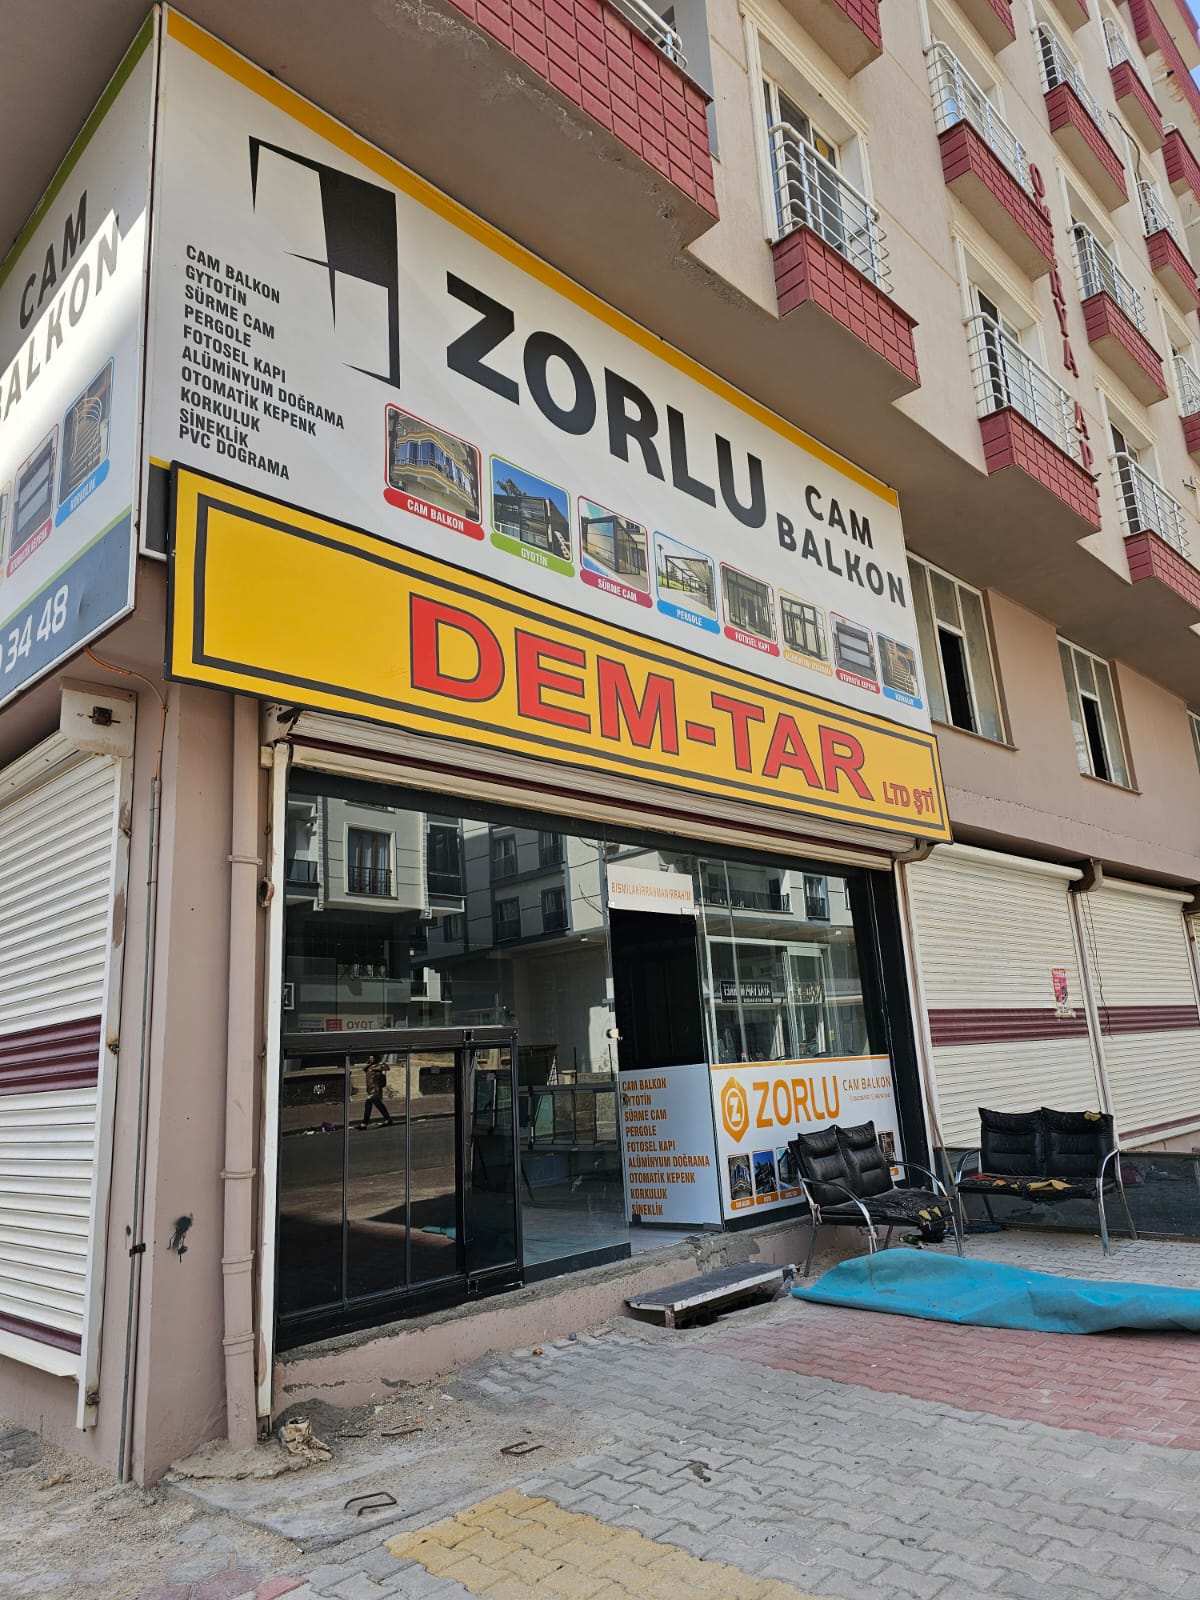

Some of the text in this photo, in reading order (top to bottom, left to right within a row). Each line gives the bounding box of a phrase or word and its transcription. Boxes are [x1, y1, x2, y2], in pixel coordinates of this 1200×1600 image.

[20, 189, 87, 330] CAM
[186, 245, 280, 304] CAM BALKON
[185, 264, 247, 306] GYTOTİN
[0, 213, 120, 422] ALKON
[184, 304, 251, 347] PERGOLE
[185, 284, 275, 339] SÜRME CAM
[183, 324, 286, 383] FOTOSEL KAPI
[181, 366, 317, 436] OTOMATİK KEPENK
[181, 386, 260, 432] KORKULUK
[182, 345, 344, 430] ALÜMİNYUM DOĞRAMA
[447, 271, 766, 528] ZORLU
[180, 407, 249, 448] SİNEKLİK
[179, 424, 289, 480] PVC DOGRAMA
[407, 499, 464, 532] CAM BALKON
[805, 485, 873, 550] CAM
[521, 547, 548, 567] GYOTİN
[777, 512, 906, 608] BALKON
[5, 614, 32, 674] 34
[37, 584, 69, 642] 48
[409, 592, 875, 801] DEM-TAR
[882, 781, 935, 815] LTD ŞTİ
[622, 1077, 666, 1092] CAM BALKON
[623, 1093, 651, 1107] YTOTİN
[752, 1075, 839, 1128] ZORLU
[843, 1078, 859, 1091] CAM
[861, 1076, 891, 1090] BALKON
[625, 1108, 667, 1122] SÜRME CAM
[626, 1125, 657, 1137] PERGOLE
[627, 1140, 676, 1152] FOTOSEL KAPI
[628, 1154, 710, 1168] ALÜMİNYUM DOĞRAMA
[629, 1170, 696, 1183] OTOMATİK KEPENK
[630, 1188, 667, 1199] KORKULUK
[632, 1201, 663, 1216] SİNEKLİK
